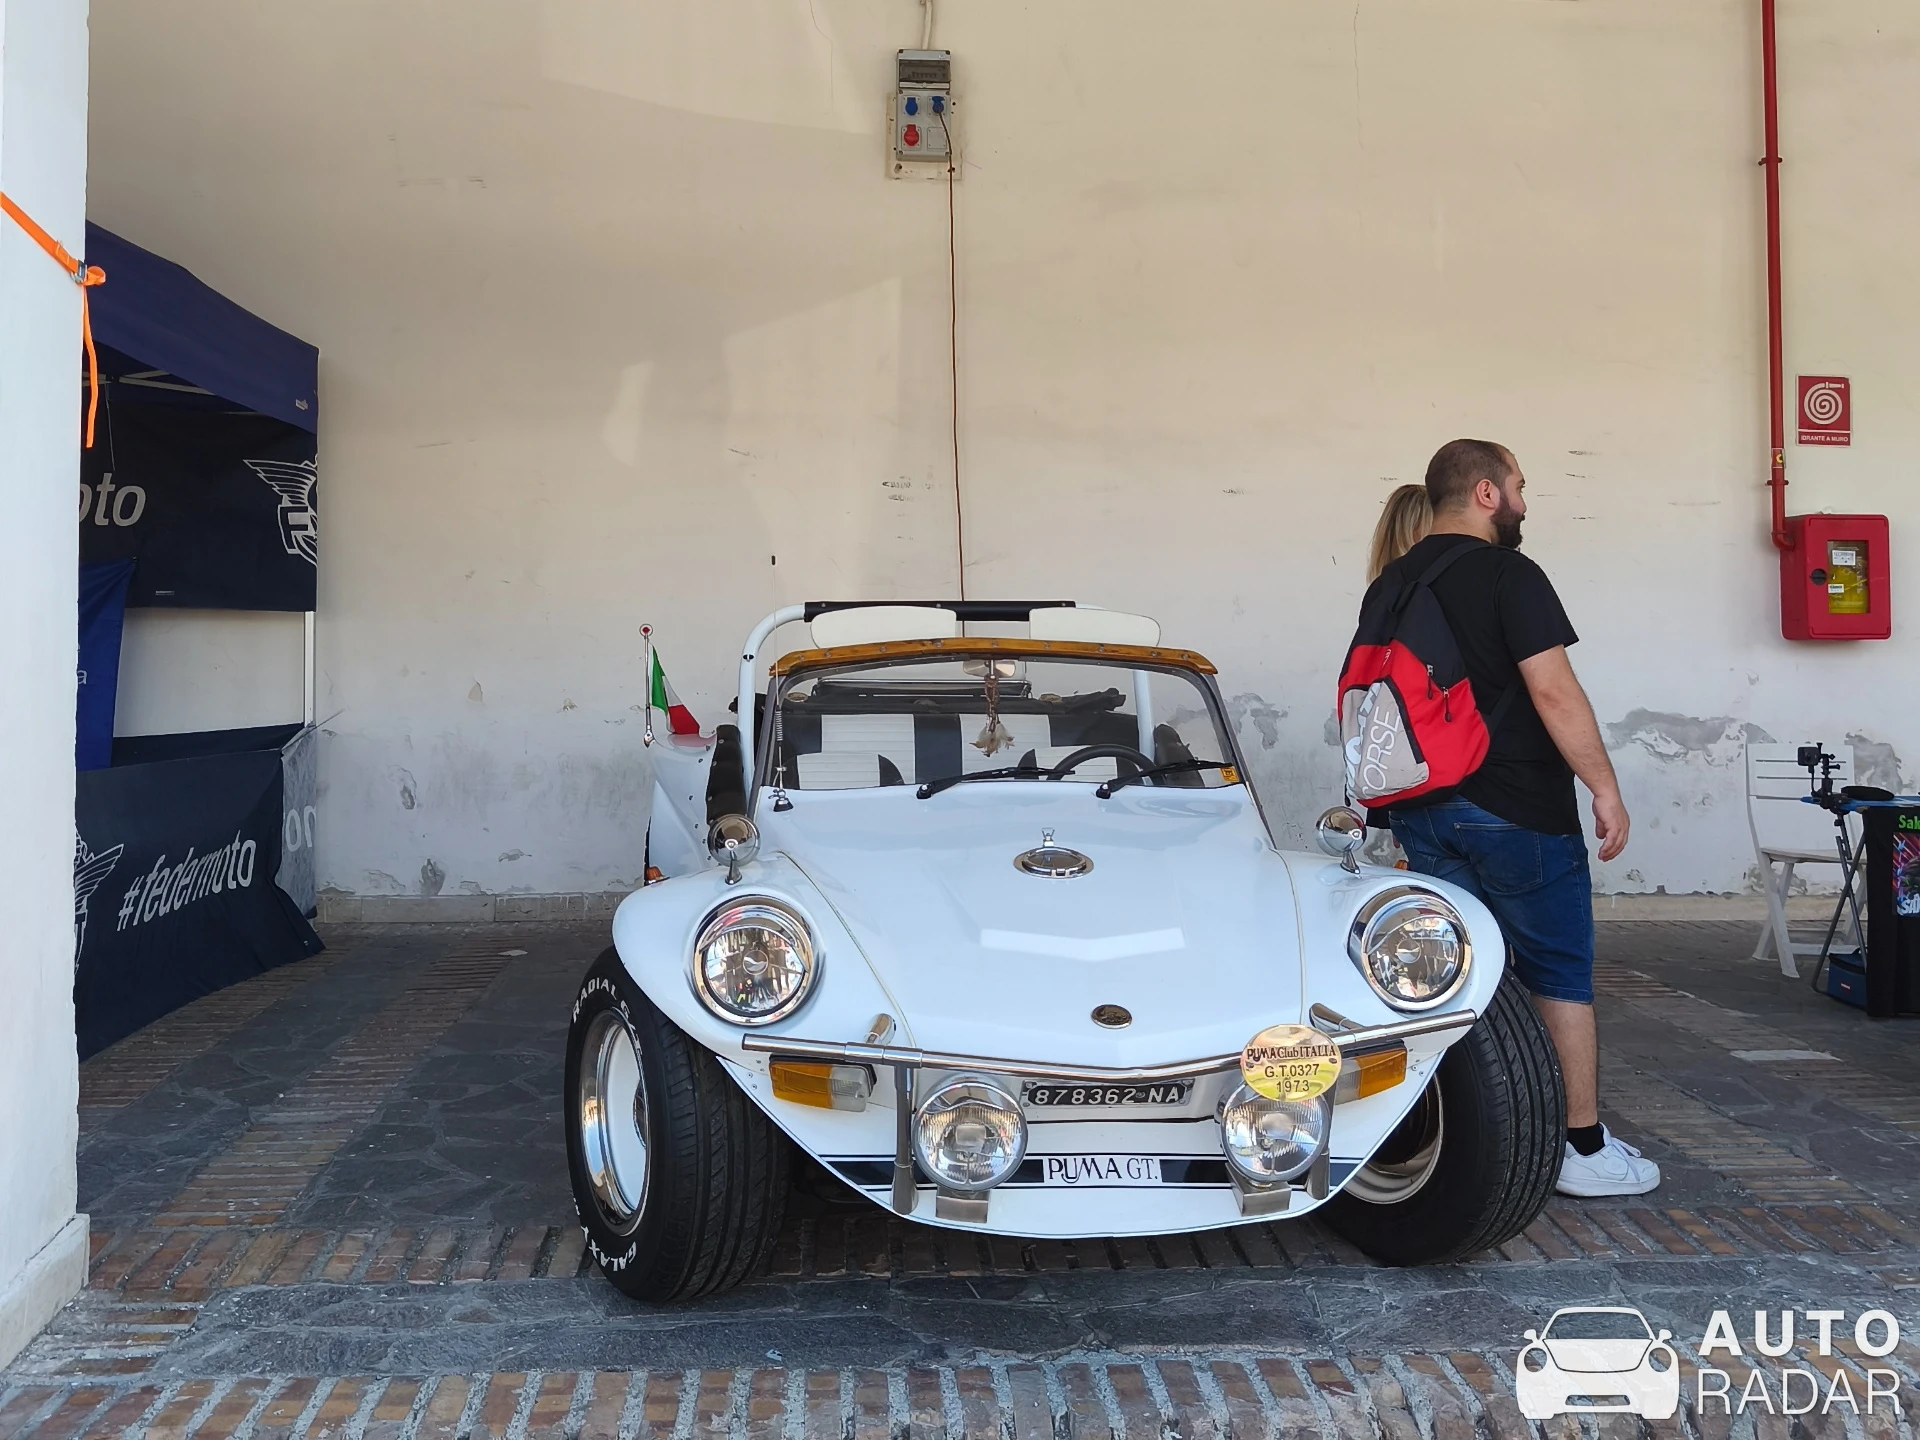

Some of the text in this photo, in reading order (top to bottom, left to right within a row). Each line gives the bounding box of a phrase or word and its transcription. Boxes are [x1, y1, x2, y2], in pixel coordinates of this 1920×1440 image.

[116, 829, 257, 932] #federmoto
[572, 976, 618, 1024] RADIAL
[1034, 1086, 1180, 1105] 878362 NA
[1276, 1079, 1310, 1093] 1973
[1048, 1157, 1123, 1184] PUMA
[580, 1225, 638, 1272] GALAXY
